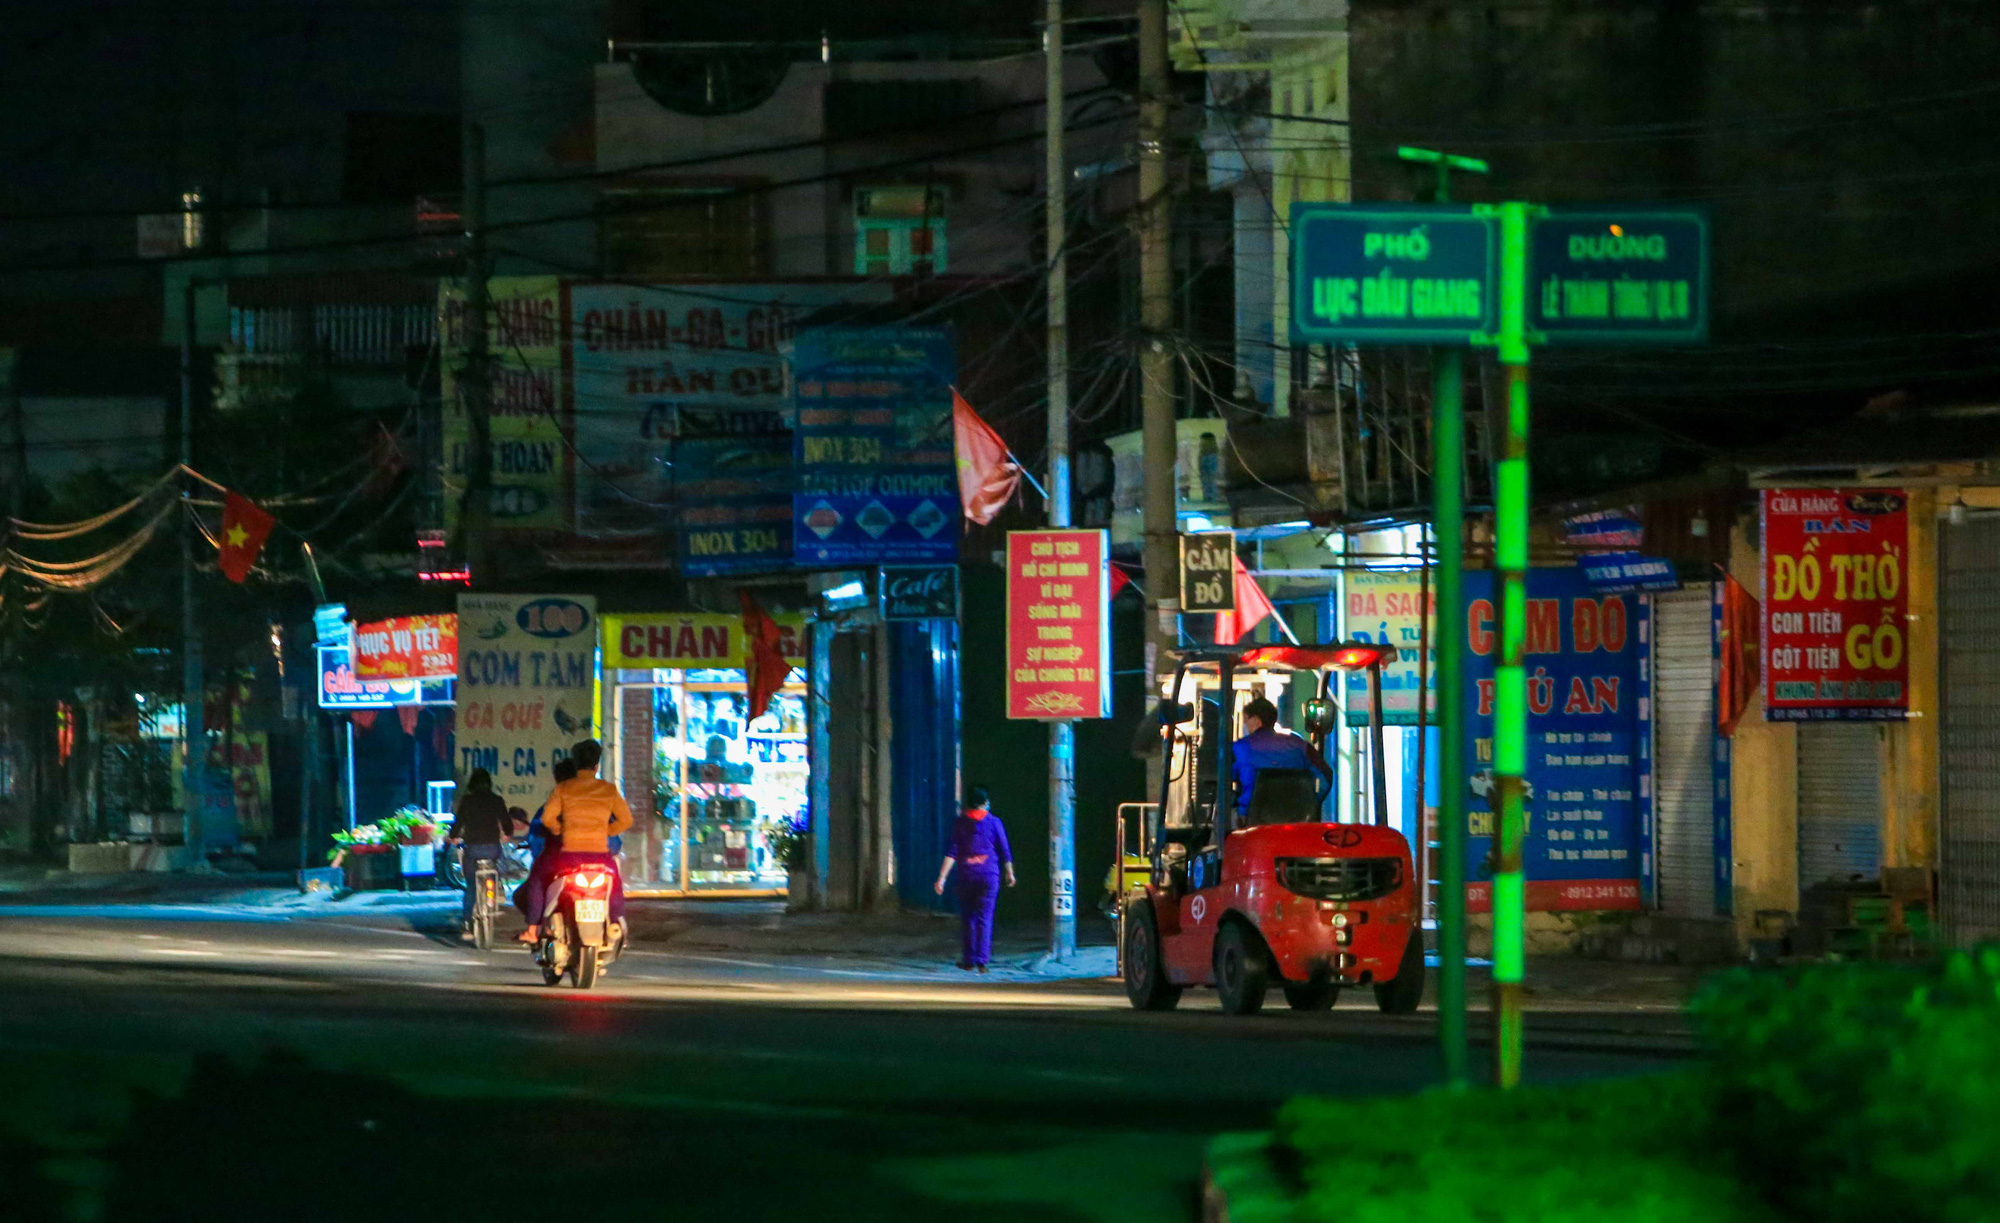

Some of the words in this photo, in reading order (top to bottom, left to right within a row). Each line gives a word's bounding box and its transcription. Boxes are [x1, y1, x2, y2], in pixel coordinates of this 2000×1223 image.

[1364, 224, 1429, 261] PHỐ
[878, 472, 950, 496] OLYMPIC
[1801, 494, 1839, 512] HÀNG
[1804, 517, 1871, 534] BÁN
[689, 531, 737, 557] INOX
[741, 528, 779, 555] 304
[1186, 539, 1230, 572] CẦM
[1773, 537, 1821, 601] ĐỒ
[1830, 540, 1900, 601] THỜ
[1194, 572, 1224, 605] ĐỒ
[1350, 589, 1378, 617] ĐÁ
[524, 604, 584, 632] 100
[1468, 598, 1561, 655] CM
[1771, 612, 1804, 634] CON
[391, 629, 412, 657] VỤ
[414, 624, 440, 651] TẾT
[621, 617, 728, 658] CHĂN
[1845, 606, 1903, 670] GỖ
[1772, 644, 1802, 674] CỘT
[1476, 667, 1554, 716] PÚ
[1564, 677, 1620, 714] AN
